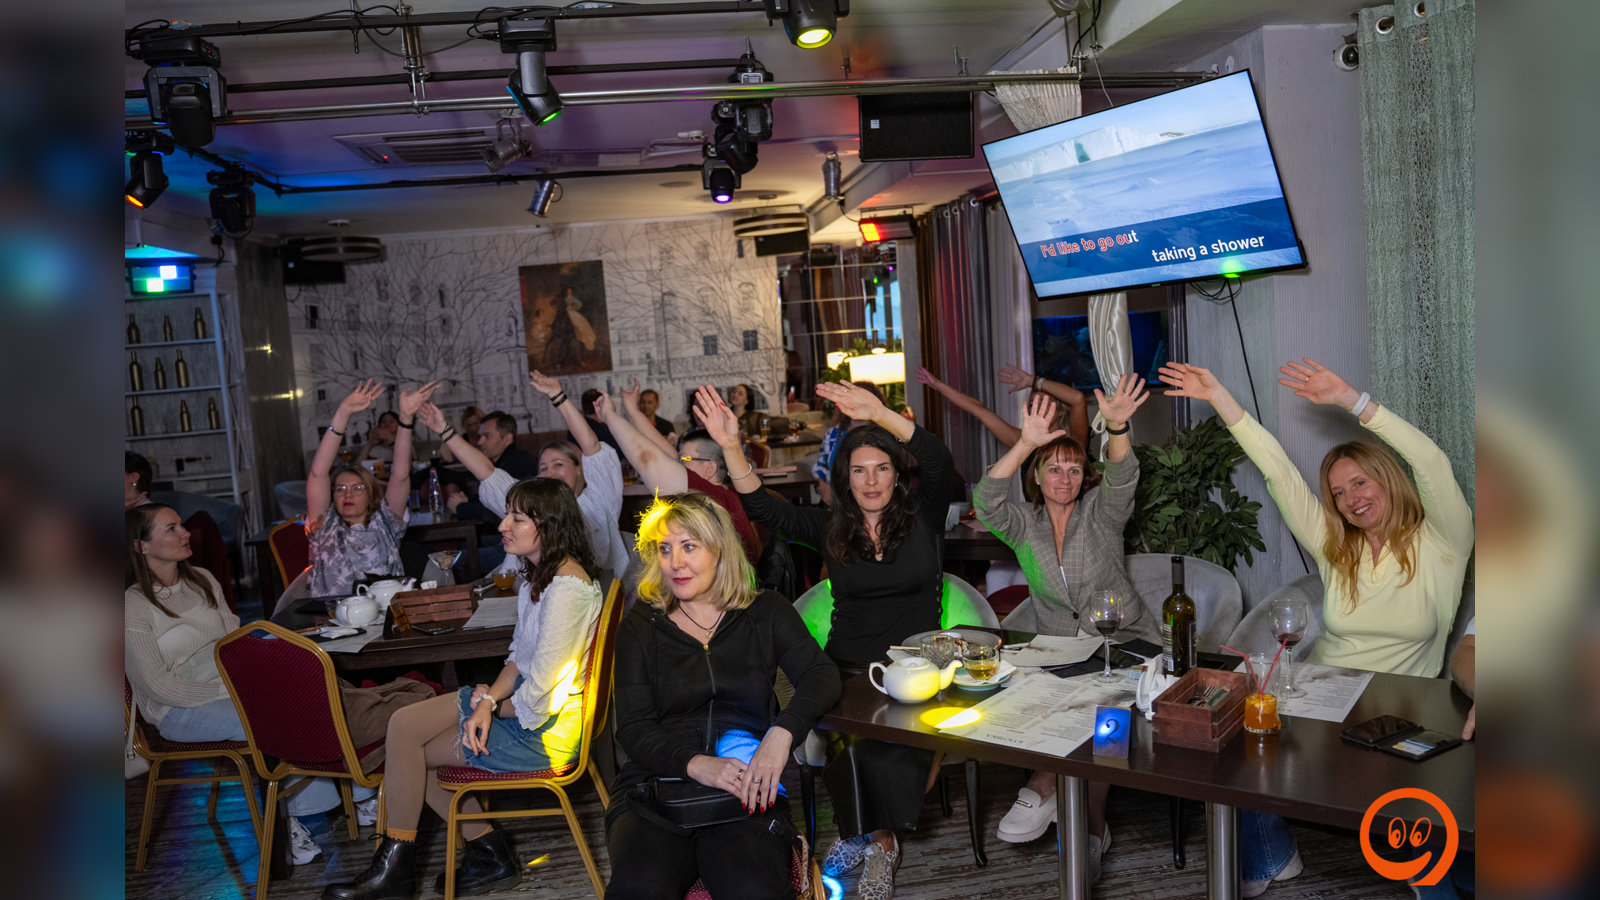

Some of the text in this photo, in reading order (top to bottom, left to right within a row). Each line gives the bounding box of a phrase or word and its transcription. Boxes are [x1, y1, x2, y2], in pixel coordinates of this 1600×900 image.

[1040, 229, 1139, 258] I'd like to go out
[1151, 235, 1265, 262] taking a shower
[1103, 718, 1120, 744] 2
